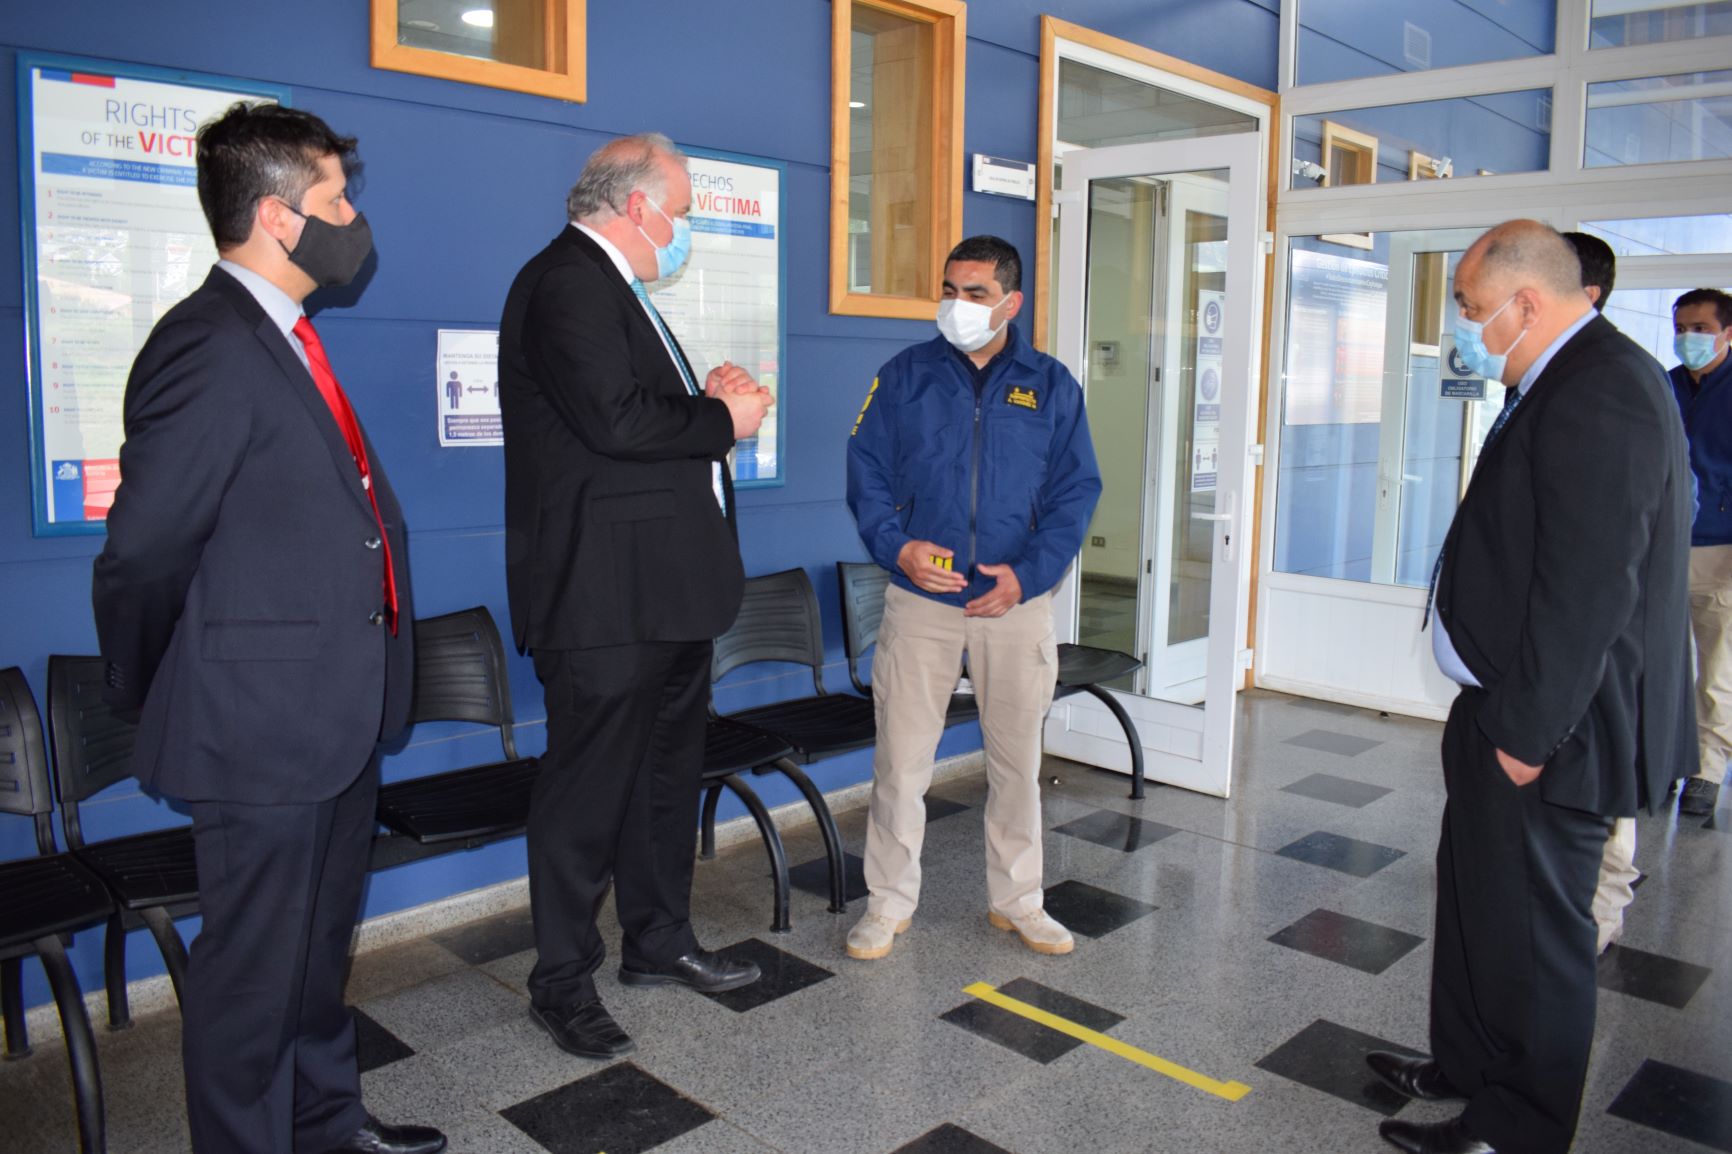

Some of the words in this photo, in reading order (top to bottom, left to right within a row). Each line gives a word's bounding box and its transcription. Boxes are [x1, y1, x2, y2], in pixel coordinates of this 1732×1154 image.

[105, 99, 197, 132] RIGHTS
[81, 131, 101, 145] OF
[107, 132, 135, 150] THE
[138, 131, 197, 157] VICT
[688, 172, 734, 192] ECHOS
[697, 191, 762, 216] VÍCTIMA
